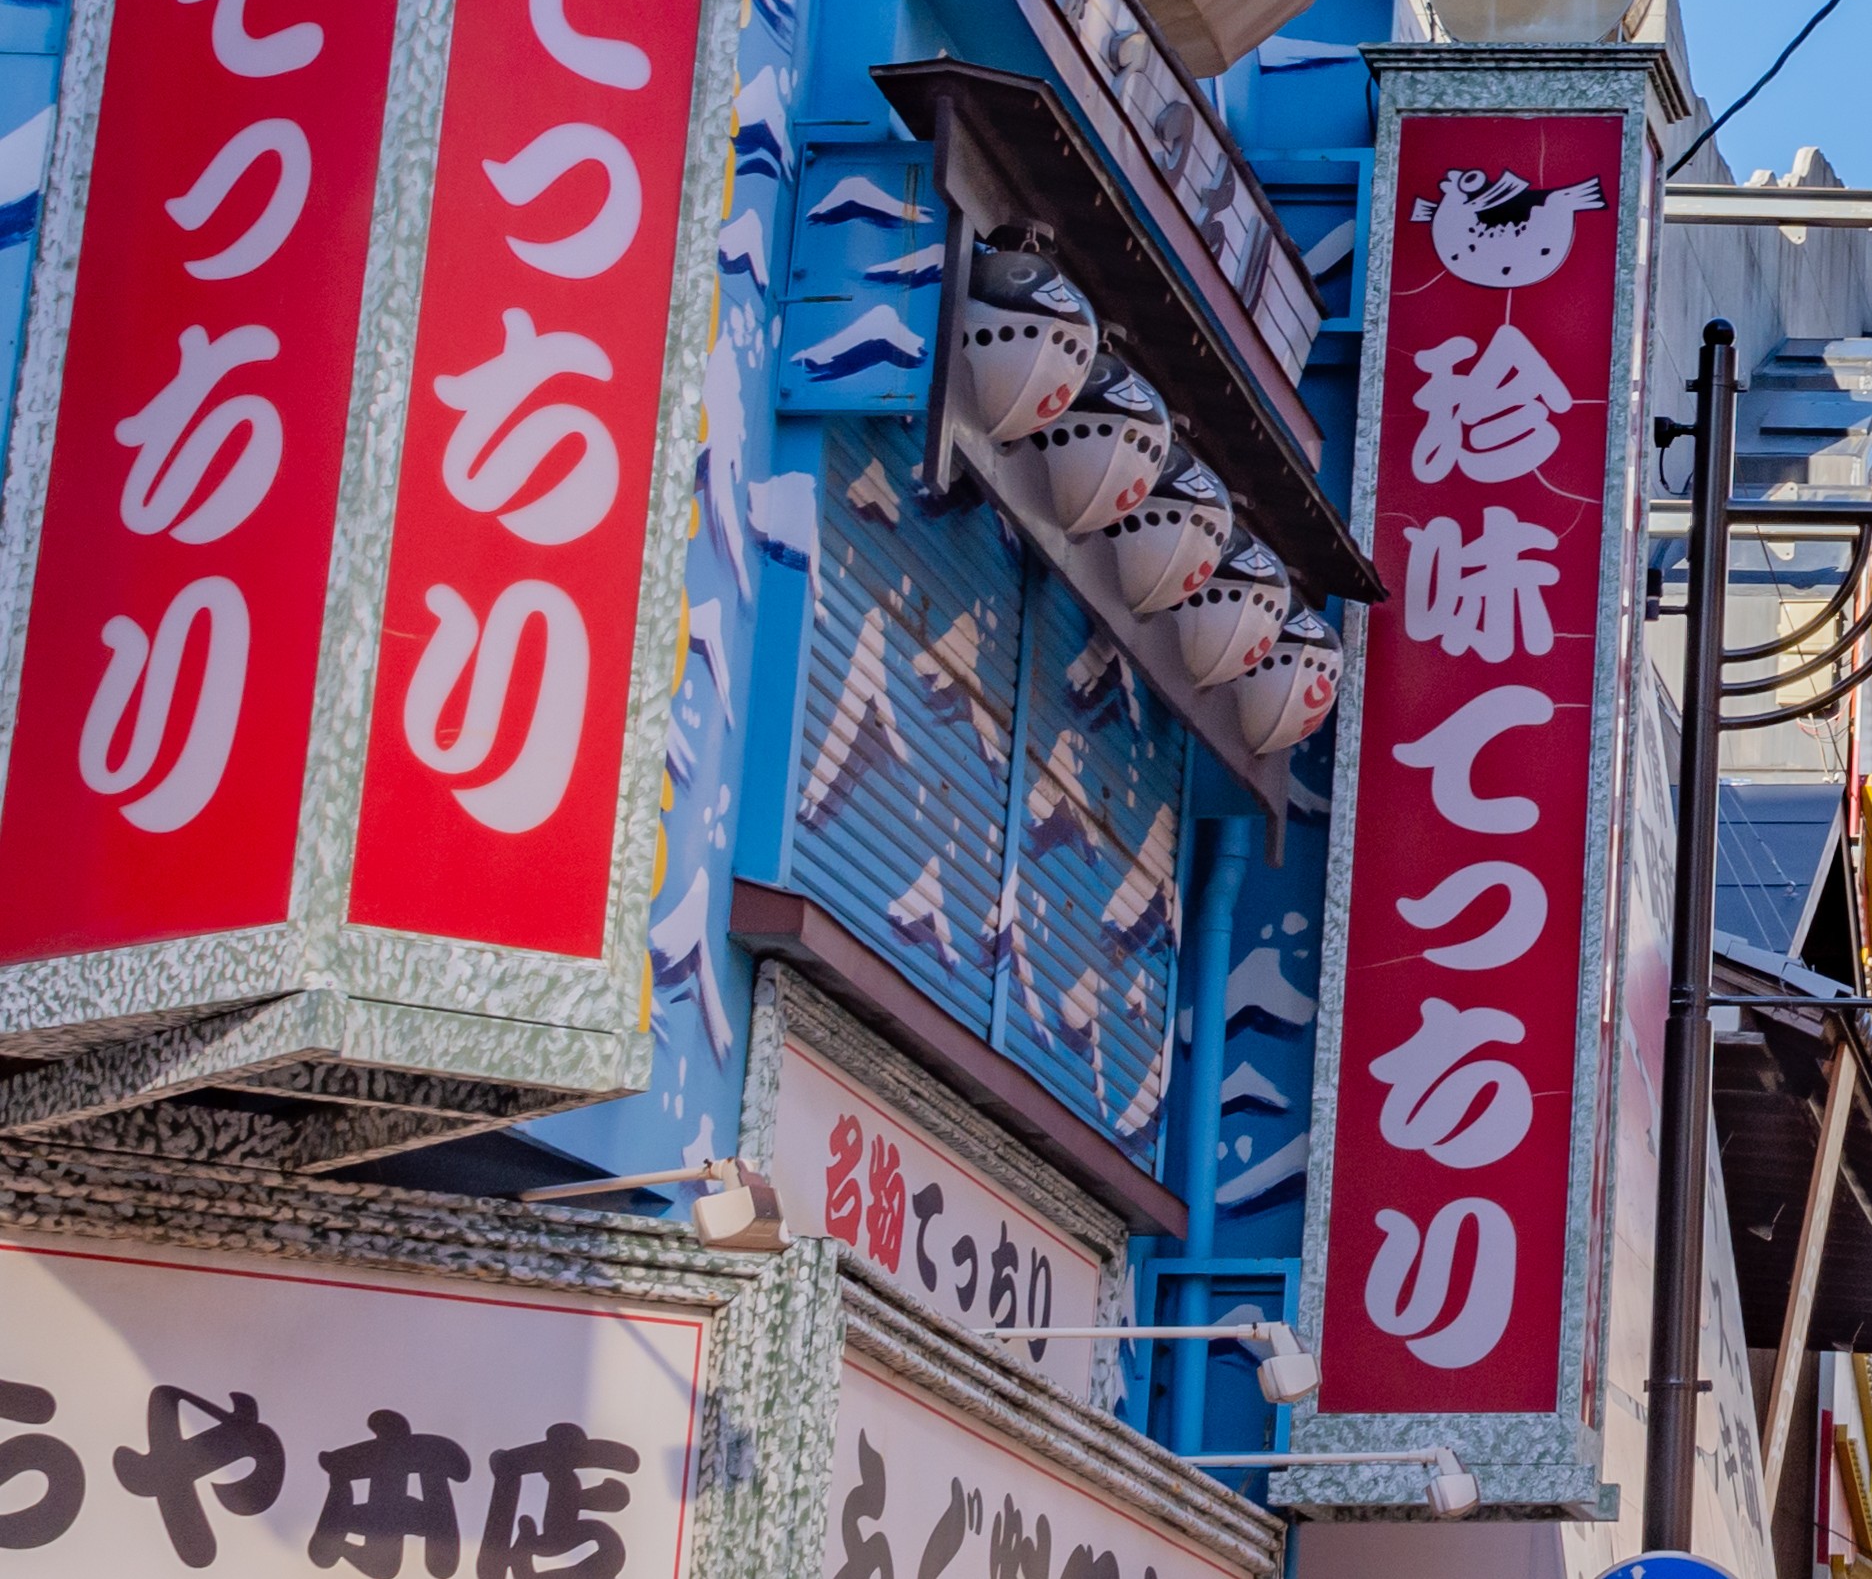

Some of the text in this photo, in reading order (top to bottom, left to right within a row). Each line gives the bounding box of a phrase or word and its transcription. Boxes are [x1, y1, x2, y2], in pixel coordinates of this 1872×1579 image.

[1364, 322, 1574, 1368] 珍味てっちり
